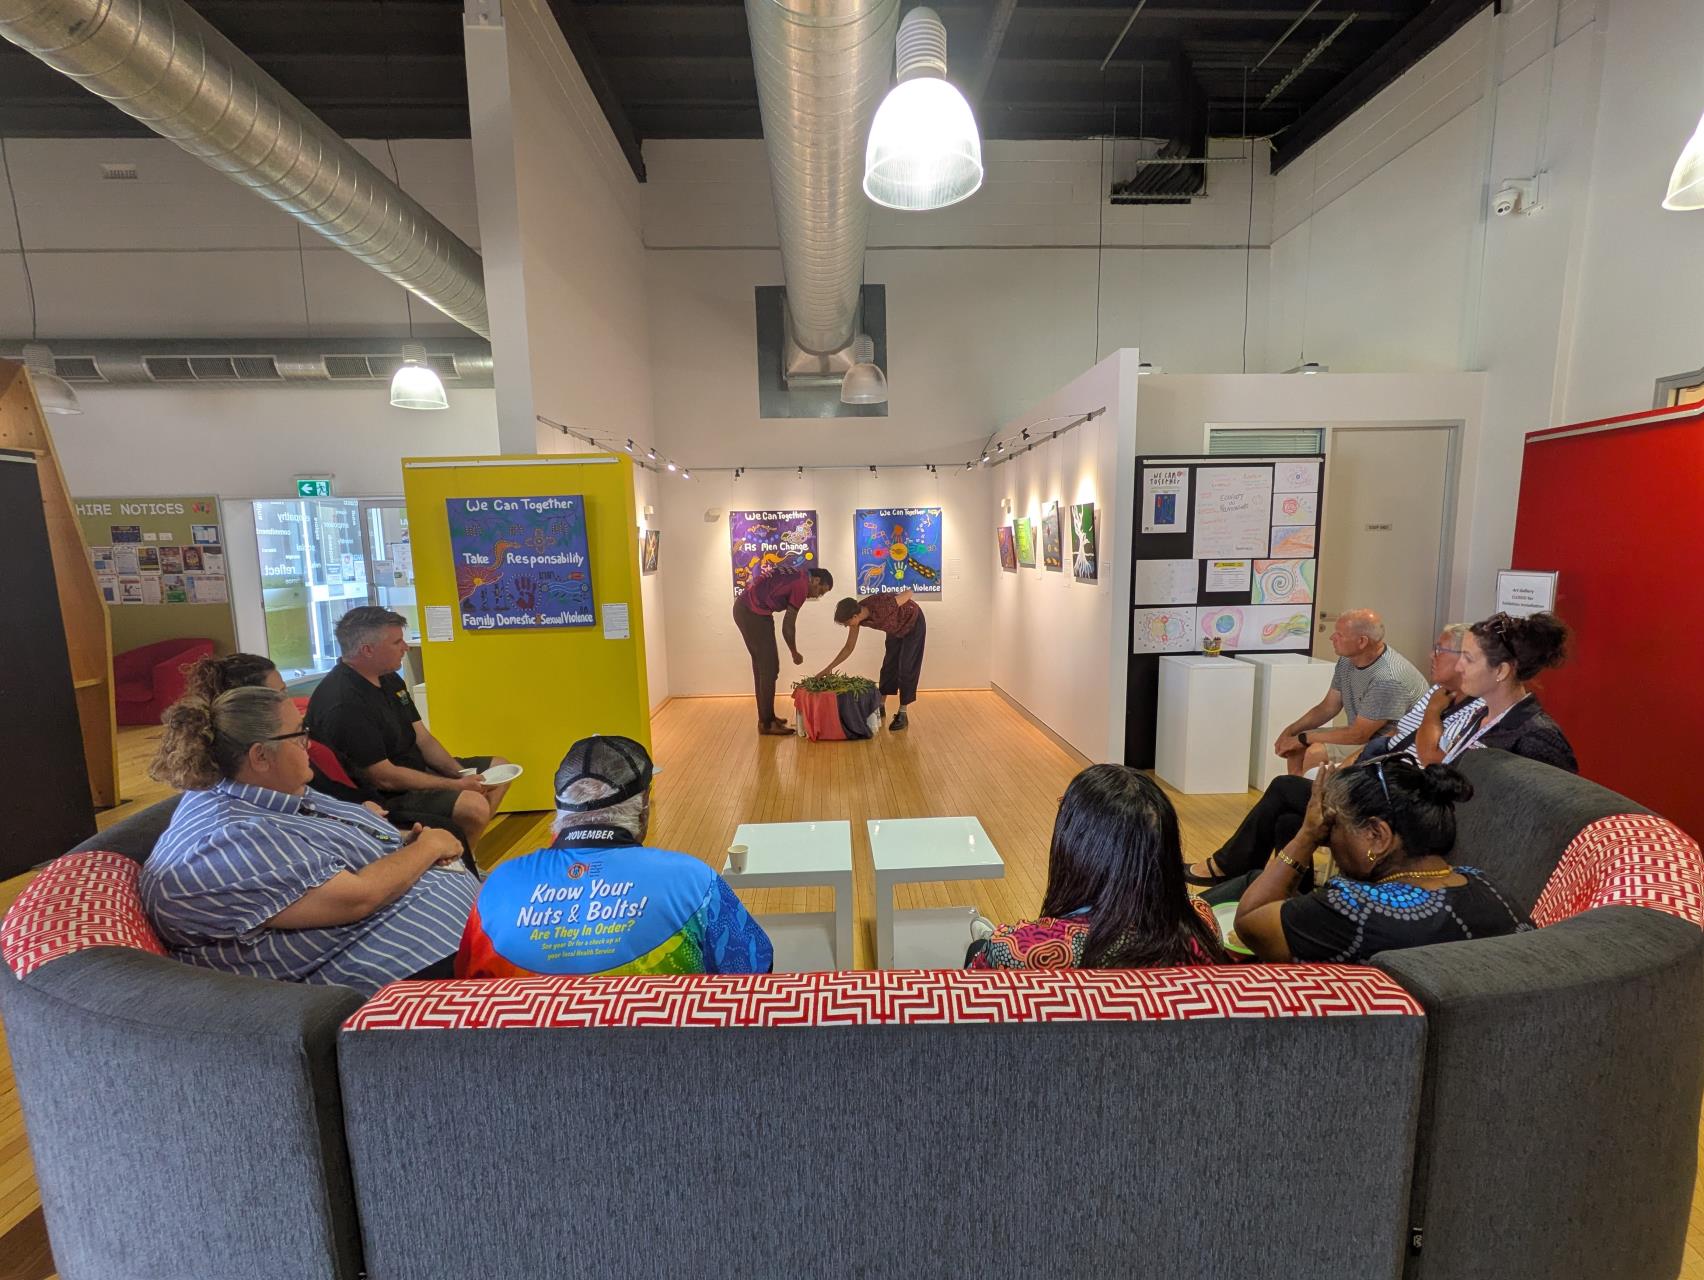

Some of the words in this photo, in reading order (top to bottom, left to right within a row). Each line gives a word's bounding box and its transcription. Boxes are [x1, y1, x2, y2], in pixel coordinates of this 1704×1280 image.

[76, 504, 112, 516] HIRE
[120, 503, 184, 515] NOTICES
[466, 500, 488, 512] We
[494, 500, 518, 511] Can
[521, 499, 574, 513] Together
[745, 512, 761, 521] We
[762, 512, 777, 521] Can
[778, 511, 807, 522] Together
[761, 543, 778, 551] Men
[780, 542, 809, 554] Change
[463, 553, 490, 565] Take
[506, 552, 584, 568] Responsability
[860, 585, 879, 595] Stop
[913, 583, 940, 592] Violence
[463, 613, 495, 629] Family
[496, 613, 535, 626] Domestic
[541, 612, 563, 625] Sexual
[563, 611, 593, 624] Violence
[565, 830, 614, 841] NOVEMBER
[530, 883, 584, 904] Know
[589, 878, 634, 899] Your
[517, 905, 562, 928] Nuts
[567, 903, 581, 923] &
[586, 896, 648, 921] Bolts!
[530, 928, 550, 941] Are
[554, 925, 580, 940] They
[581, 924, 592, 936] In
[595, 919, 636, 935] Order?
